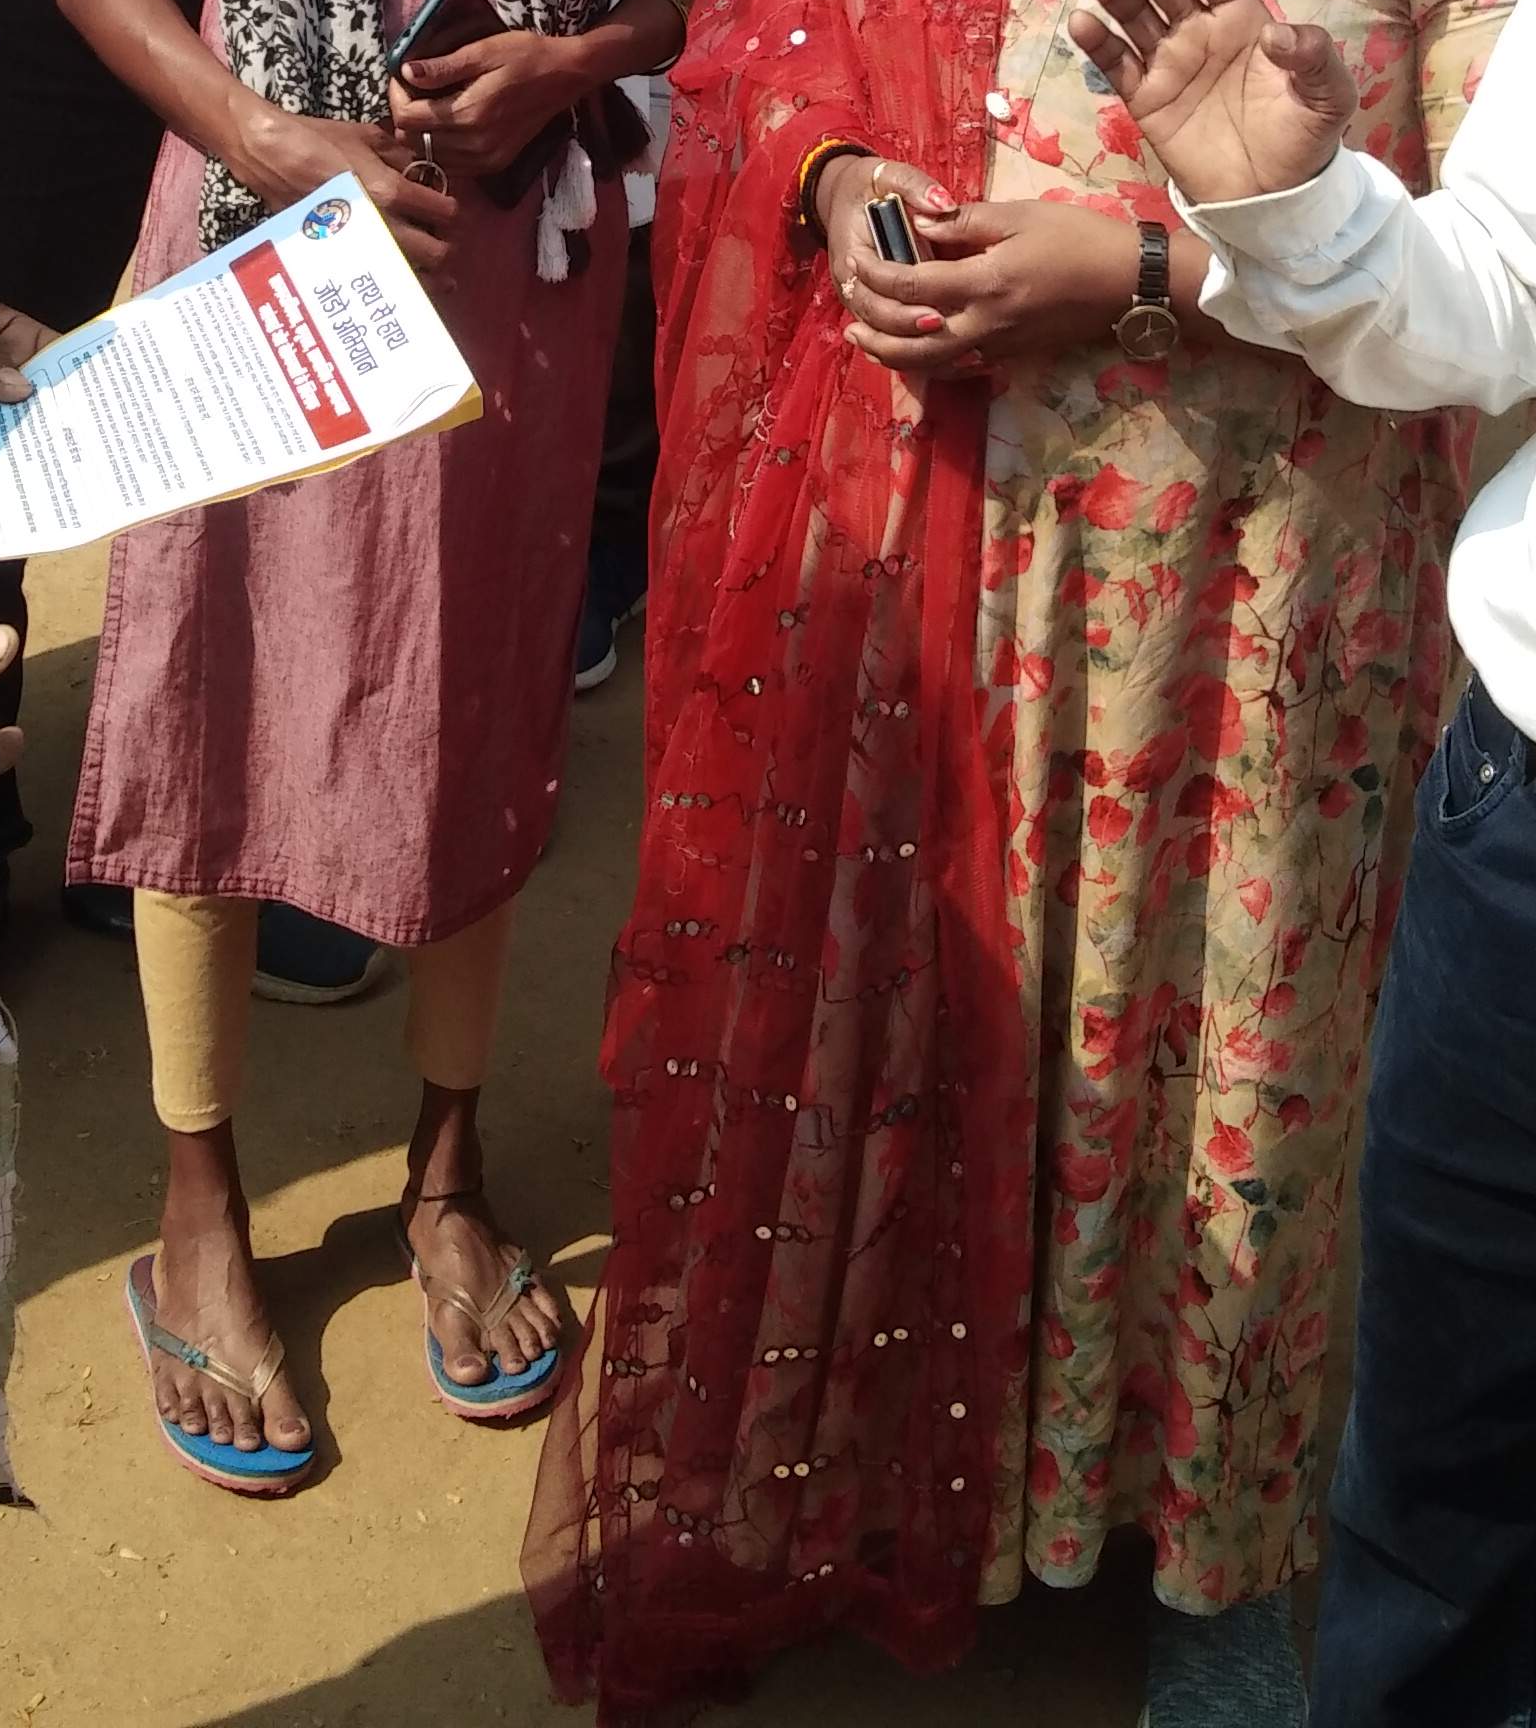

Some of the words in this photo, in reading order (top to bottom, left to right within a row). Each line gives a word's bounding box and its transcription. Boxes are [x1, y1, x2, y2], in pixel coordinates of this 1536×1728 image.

[350, 271, 384, 307] हाथ
[370, 302, 397, 323] से
[332, 316, 379, 377] अभियान
[376, 317, 410, 352] हाथ
